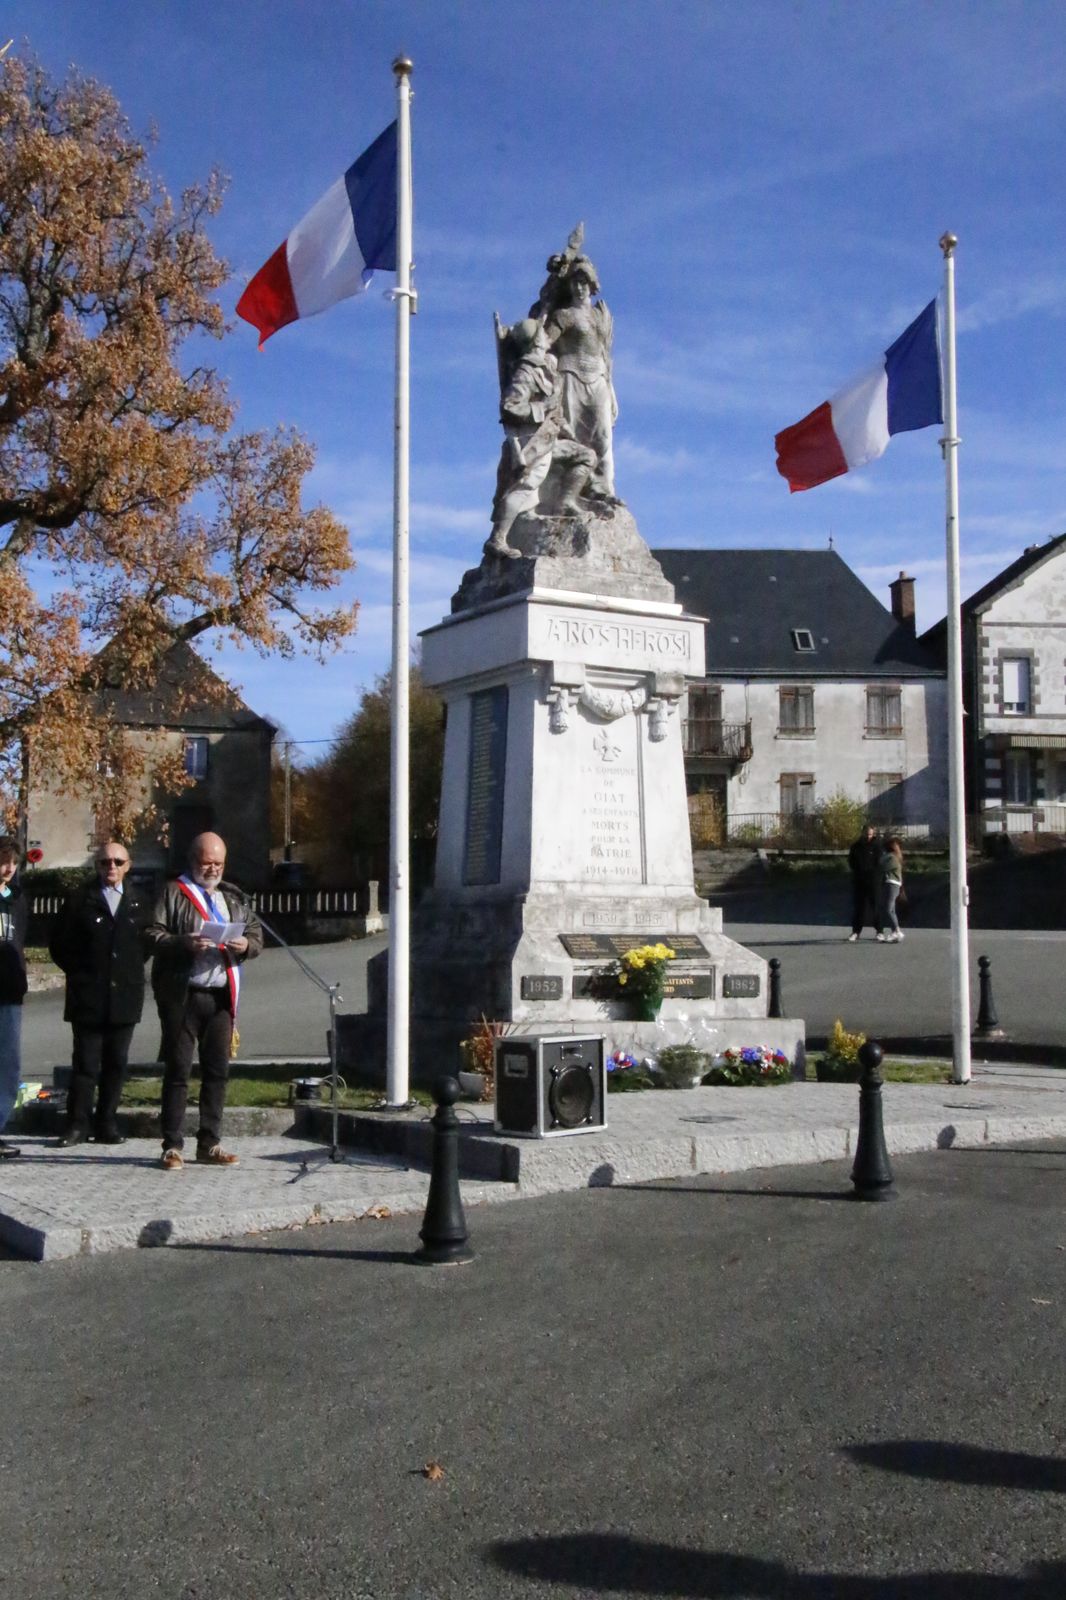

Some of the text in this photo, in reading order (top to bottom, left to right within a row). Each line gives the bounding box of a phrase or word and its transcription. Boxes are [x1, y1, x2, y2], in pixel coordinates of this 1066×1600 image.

[591, 820, 629, 831] MORTS
[590, 846, 632, 859] PATRIE
[530, 980, 557, 993] 1952
